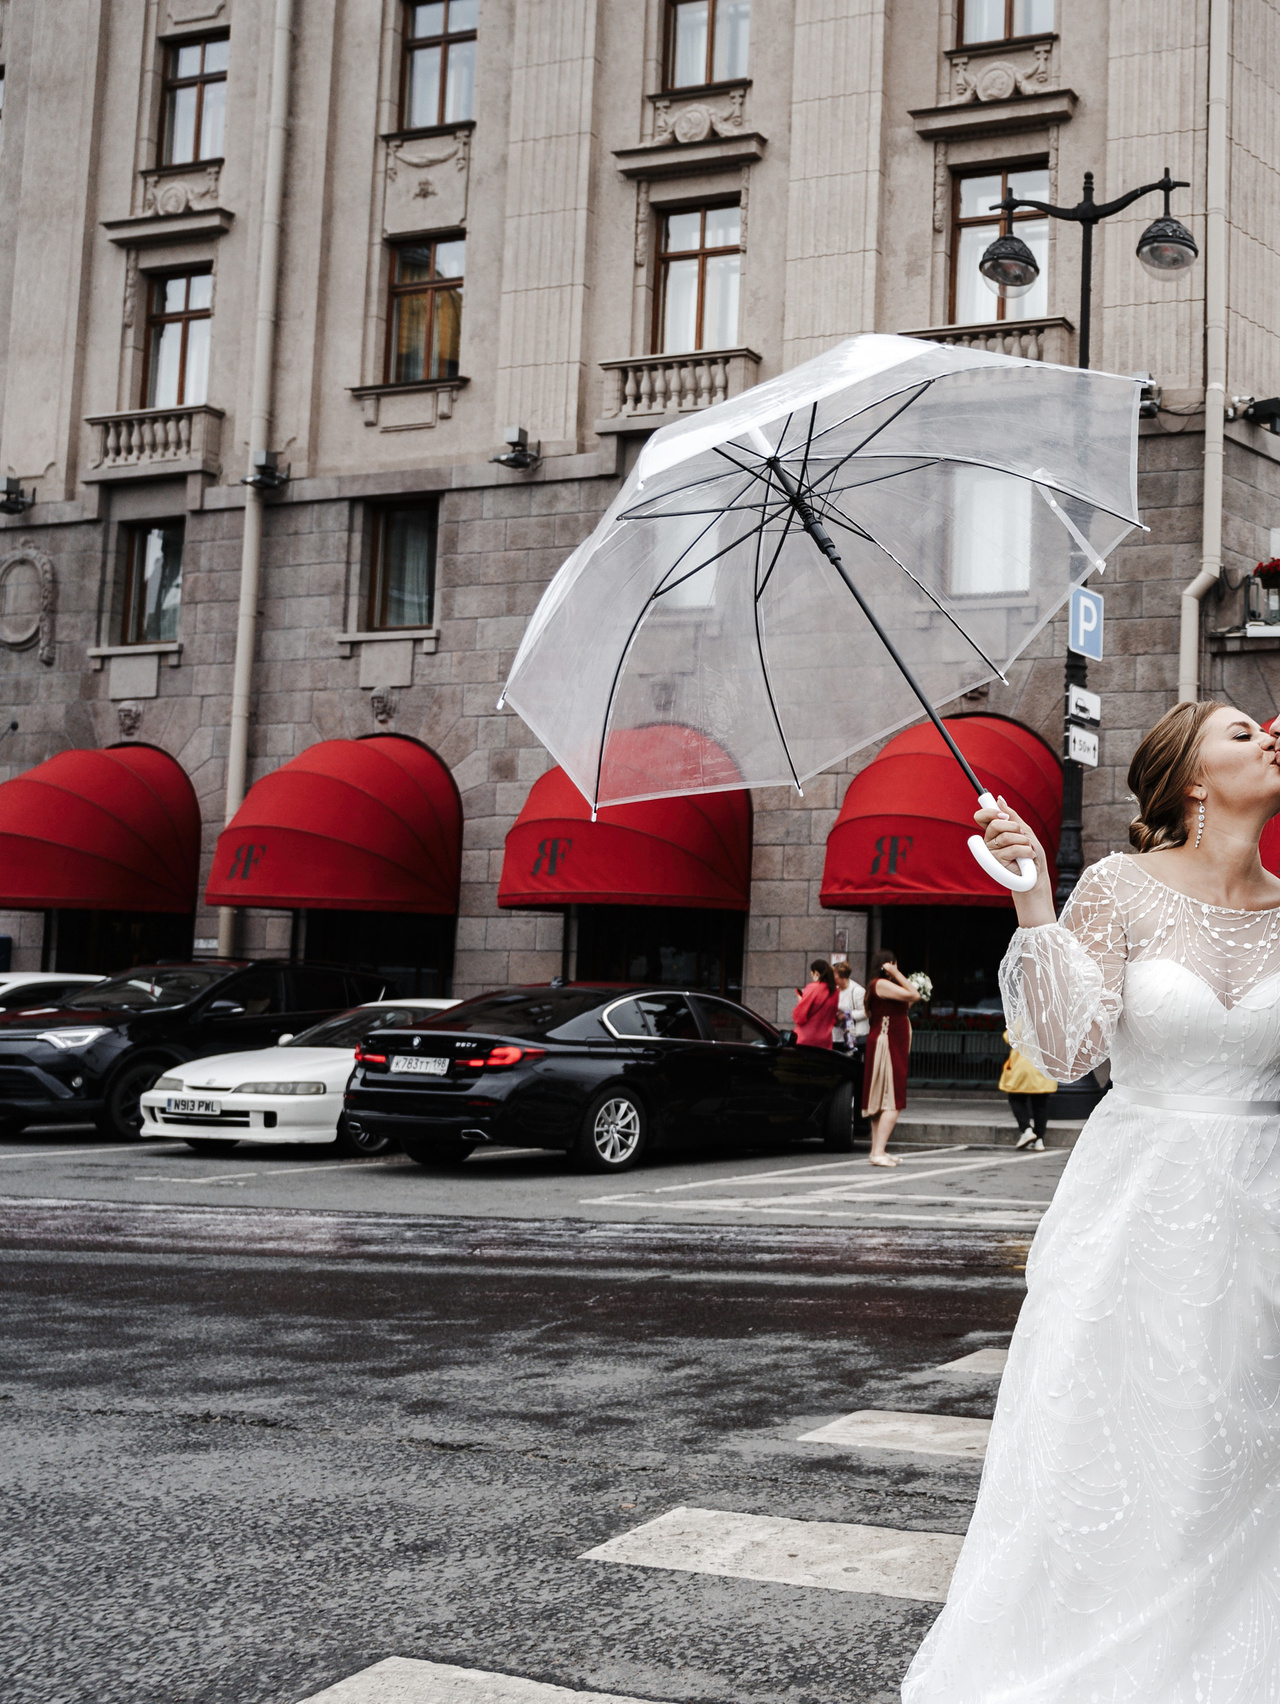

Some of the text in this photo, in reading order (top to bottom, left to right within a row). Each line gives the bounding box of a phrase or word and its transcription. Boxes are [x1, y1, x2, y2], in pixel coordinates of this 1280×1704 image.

[1078, 595, 1098, 647] P
[174, 1099, 217, 1112] N913 PWL
